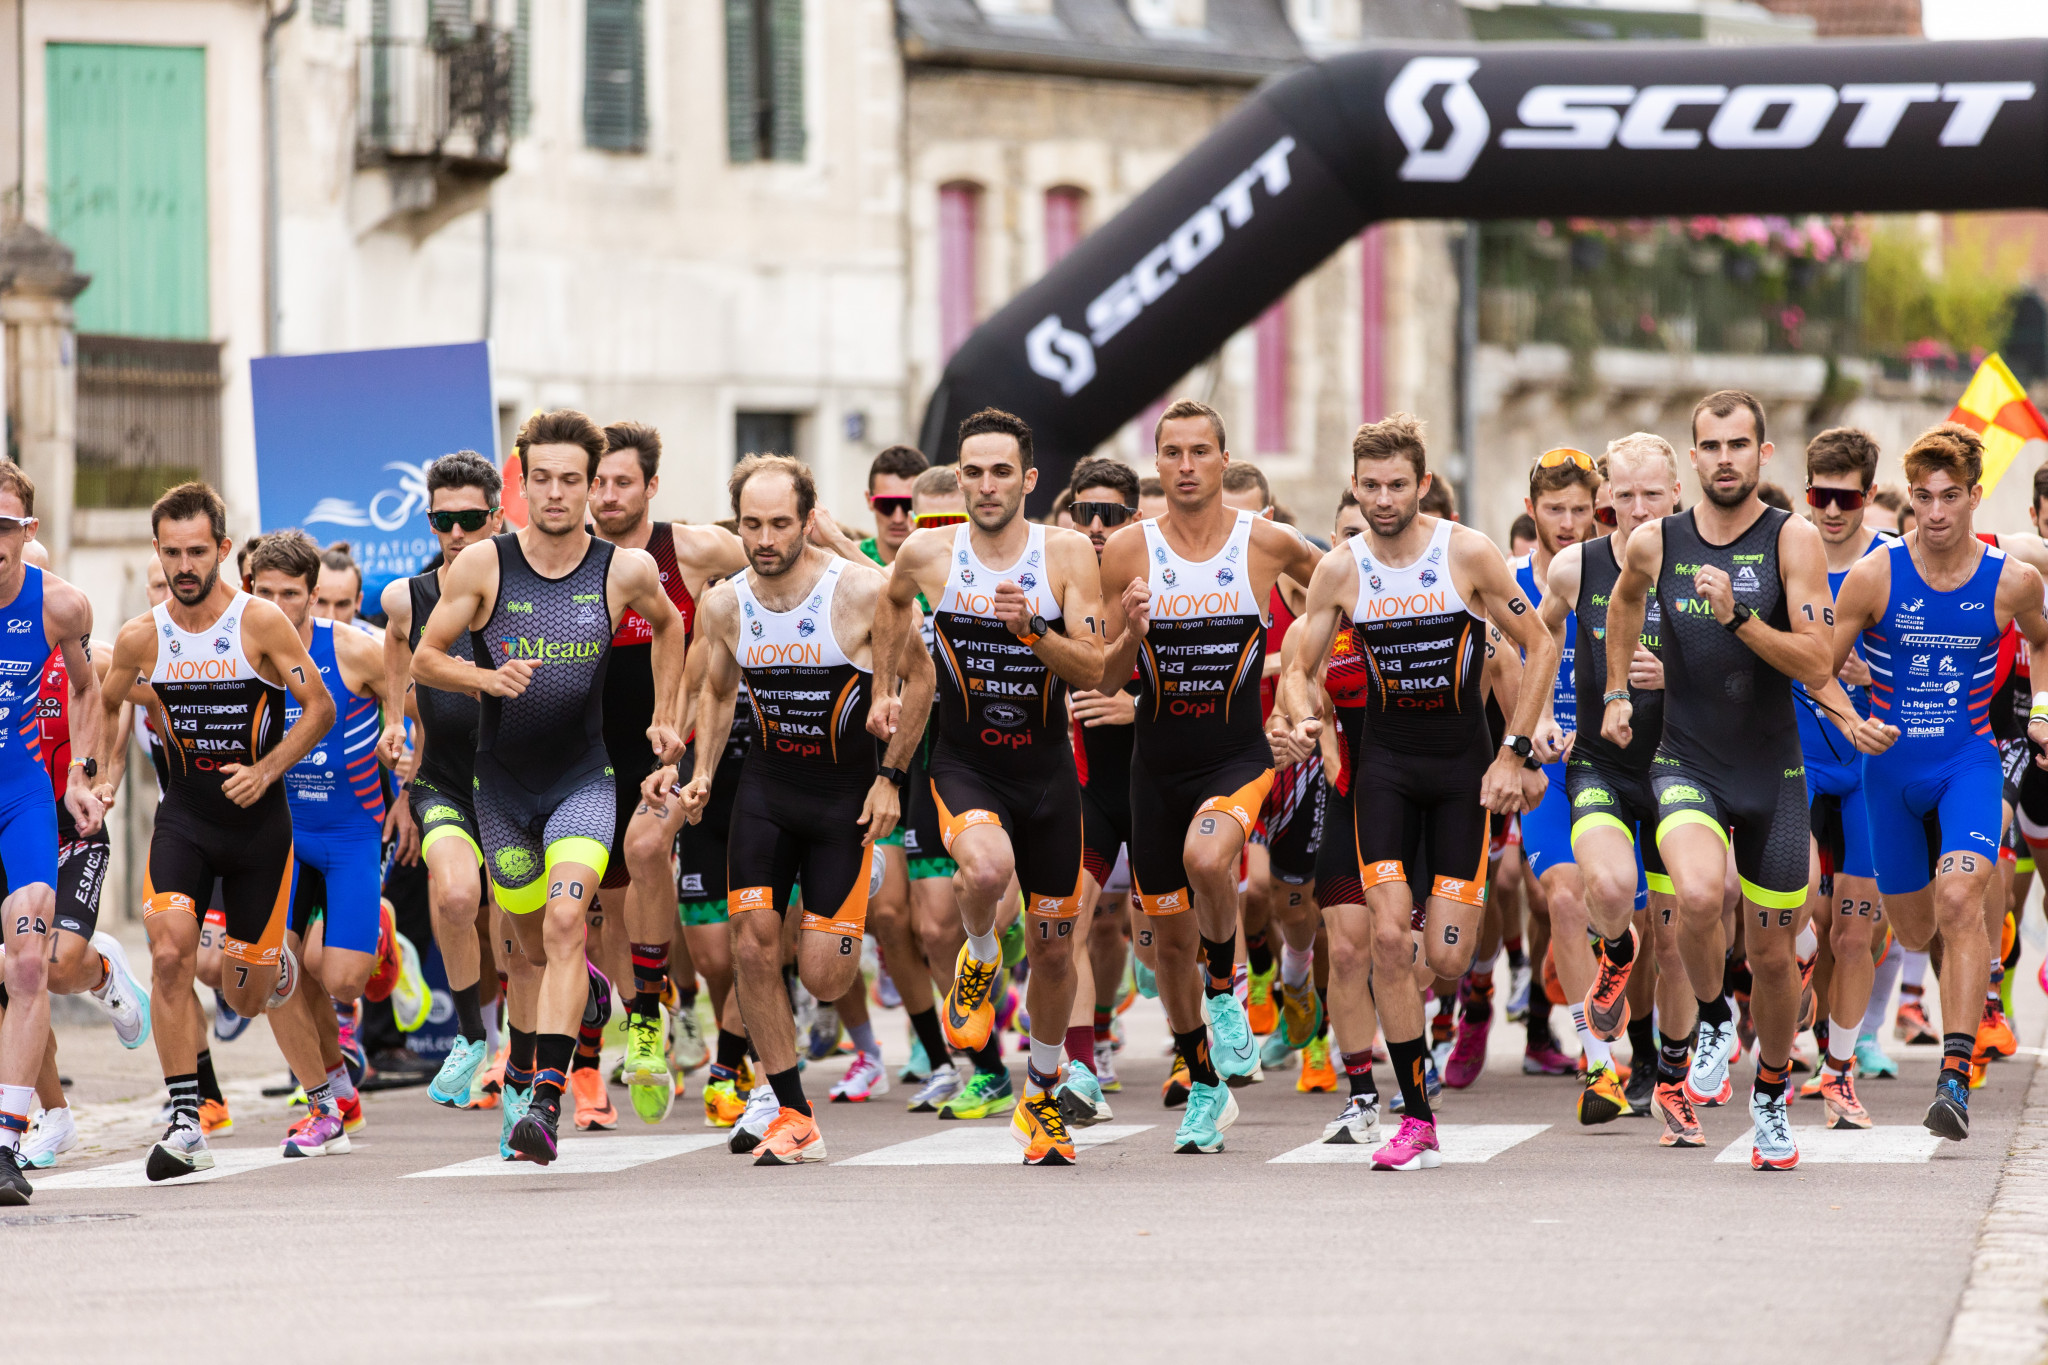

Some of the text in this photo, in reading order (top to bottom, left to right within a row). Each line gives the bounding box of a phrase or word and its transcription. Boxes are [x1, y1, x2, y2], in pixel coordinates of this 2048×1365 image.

[1501, 83, 2035, 150] SCOTT
[1086, 135, 1296, 347] SCOTT
[1155, 591, 1239, 617] NOYON
[1366, 591, 1445, 619] NOYON
[1508, 597, 1527, 616] 6
[950, 614, 1003, 629] Team Noyon
[1152, 616, 1244, 631] Team Noyon Triathlon
[1364, 615, 1454, 631] Team Noyon Triathlon
[1801, 603, 1834, 627] 16
[518, 637, 601, 658] Meaux
[746, 643, 821, 666] NOYON
[968, 640, 1034, 656] INTERSPO
[1167, 642, 1240, 656] INTERSPORT
[1381, 637, 1454, 655] INTERSPORT
[166, 658, 236, 680] NOYON
[1003, 665, 1046, 673] GIANT
[1328, 655, 1361, 669] ORMANDIE
[1409, 656, 1452, 669] GIANT
[291, 665, 306, 685] 7
[765, 668, 790, 676] Noyon
[792, 667, 830, 675] Triathlon
[184, 683, 208, 692] Noyon
[209, 681, 246, 690] Triathlon
[986, 680, 1039, 696] RIKA
[1179, 680, 1225, 692] RIKA
[1401, 675, 1451, 690] RIKA
[762, 690, 830, 701] INTERSPORT
[1397, 694, 1444, 711] Orpi
[180, 704, 248, 714] INTERSPORT
[1169, 698, 1216, 718] Orpi
[1902, 700, 1944, 710] La Région
[1560, 712, 1576, 722] Rég
[780, 722, 826, 736] RIKA
[196, 739, 246, 751] RIKA
[980, 728, 1032, 750] Orpi
[776, 739, 821, 758] Orpi
[1199, 818, 1218, 836] 9
[1941, 855, 1976, 874] 25
[550, 881, 584, 900] 20
[1840, 899, 1872, 917] 22
[16, 916, 47, 936] 24
[1758, 909, 1793, 929] 16
[1039, 920, 1072, 939] 10
[1444, 924, 1460, 946] 6
[839, 936, 853, 956] 8
[235, 966, 249, 989] 7
